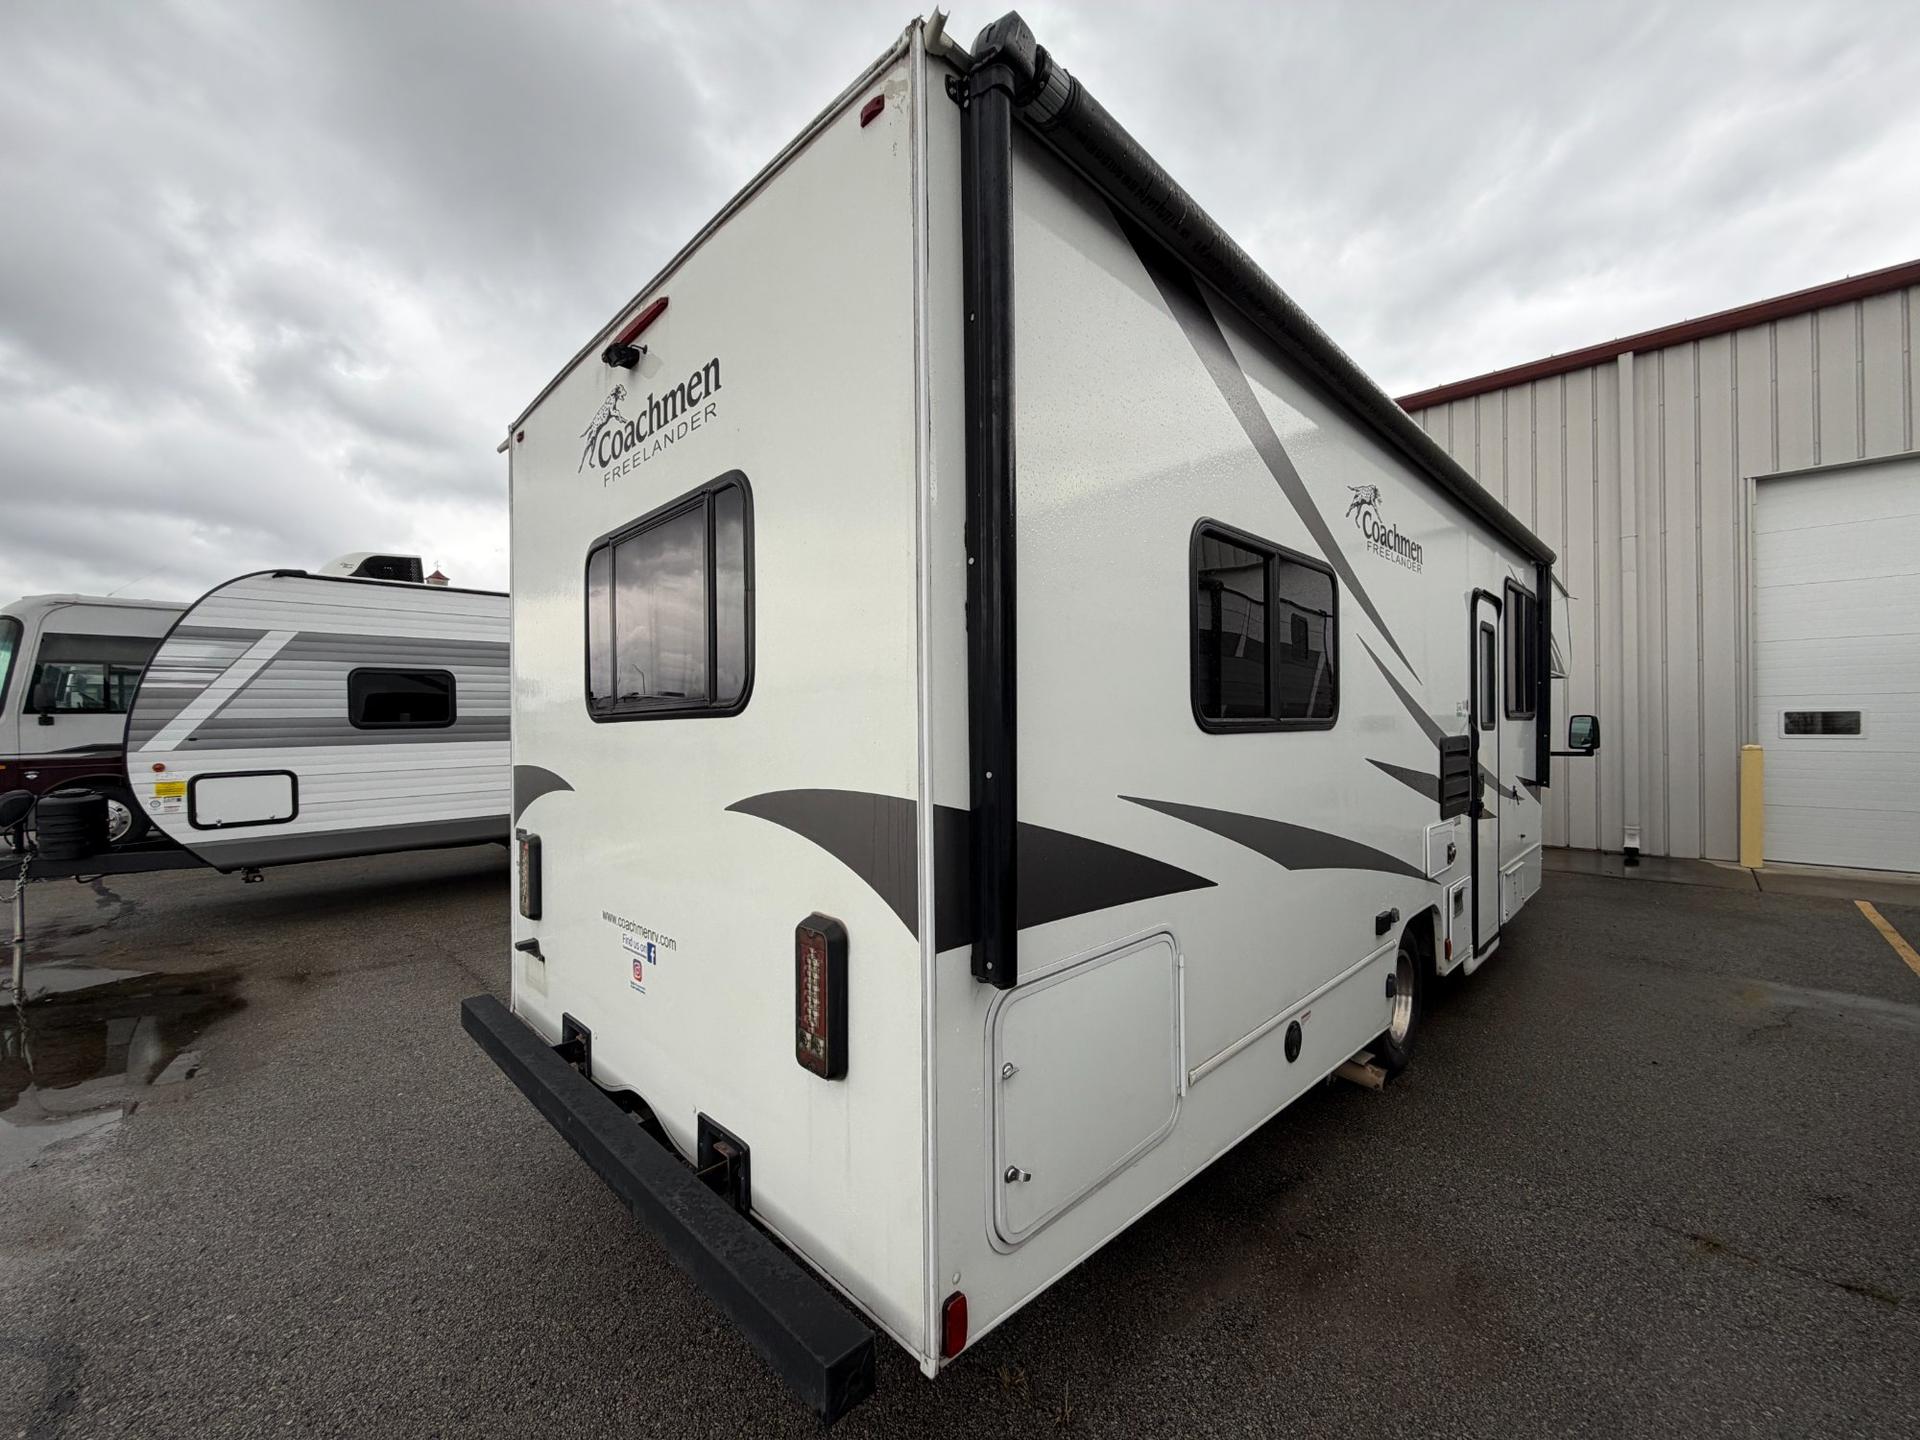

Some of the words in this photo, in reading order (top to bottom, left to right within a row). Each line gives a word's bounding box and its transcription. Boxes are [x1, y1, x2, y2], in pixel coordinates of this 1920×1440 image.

[598, 357, 722, 468] Coachmen
[604, 402, 717, 488] FREELANDER
[1362, 510, 1423, 565] Coachmen
[1367, 540, 1422, 574] FREELANDER
[602, 910, 677, 951] www.coachmenrv.com
[622, 933, 633, 947] Find
